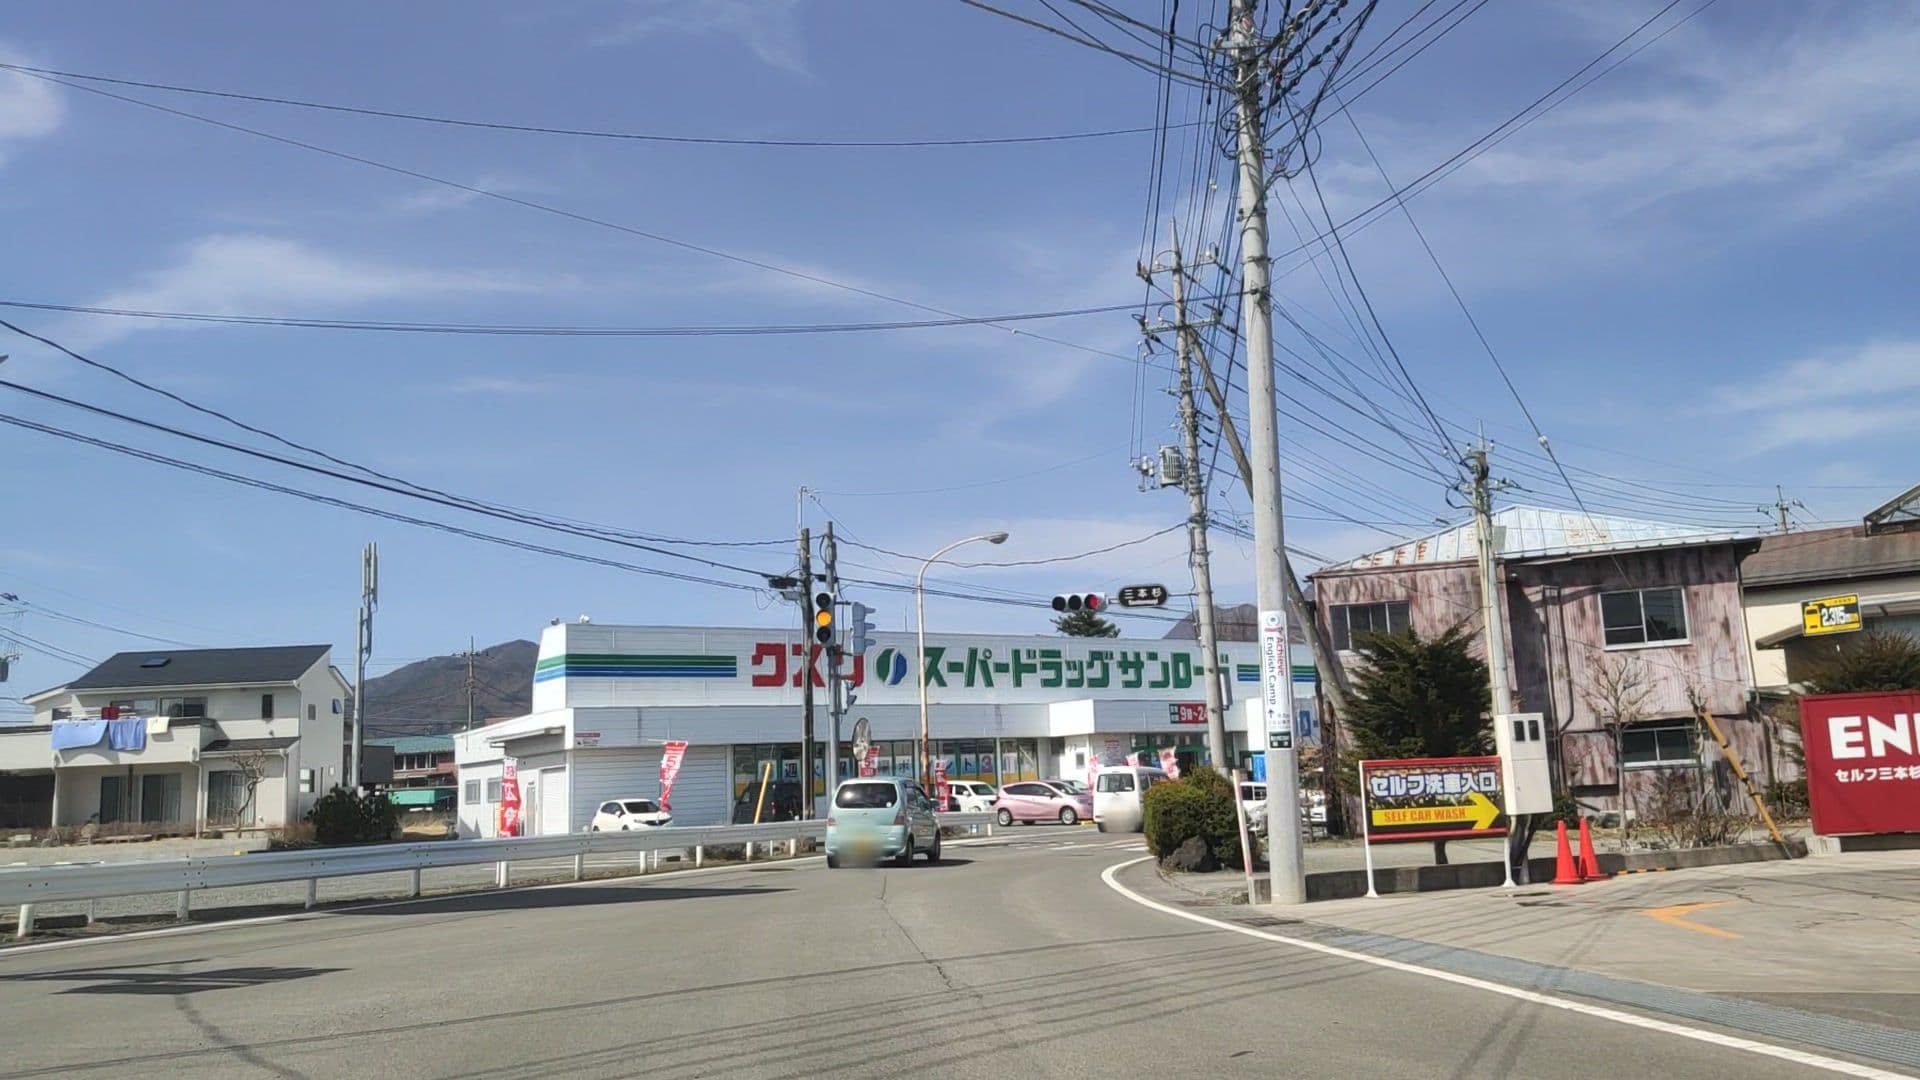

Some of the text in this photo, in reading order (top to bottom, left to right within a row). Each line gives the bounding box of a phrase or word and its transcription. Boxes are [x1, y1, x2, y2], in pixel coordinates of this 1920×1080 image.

[1124, 587, 1162, 599] 三本杉
[1276, 636, 1285, 677] Achieve
[1266, 636, 1277, 705] English Camp
[1827, 713, 1920, 760] EN
[1370, 771, 1497, 797] セルフ洗車入口
[1835, 765, 1920, 783] セルフ三本杉
[1383, 807, 1467, 823] SELF CAR WASH
